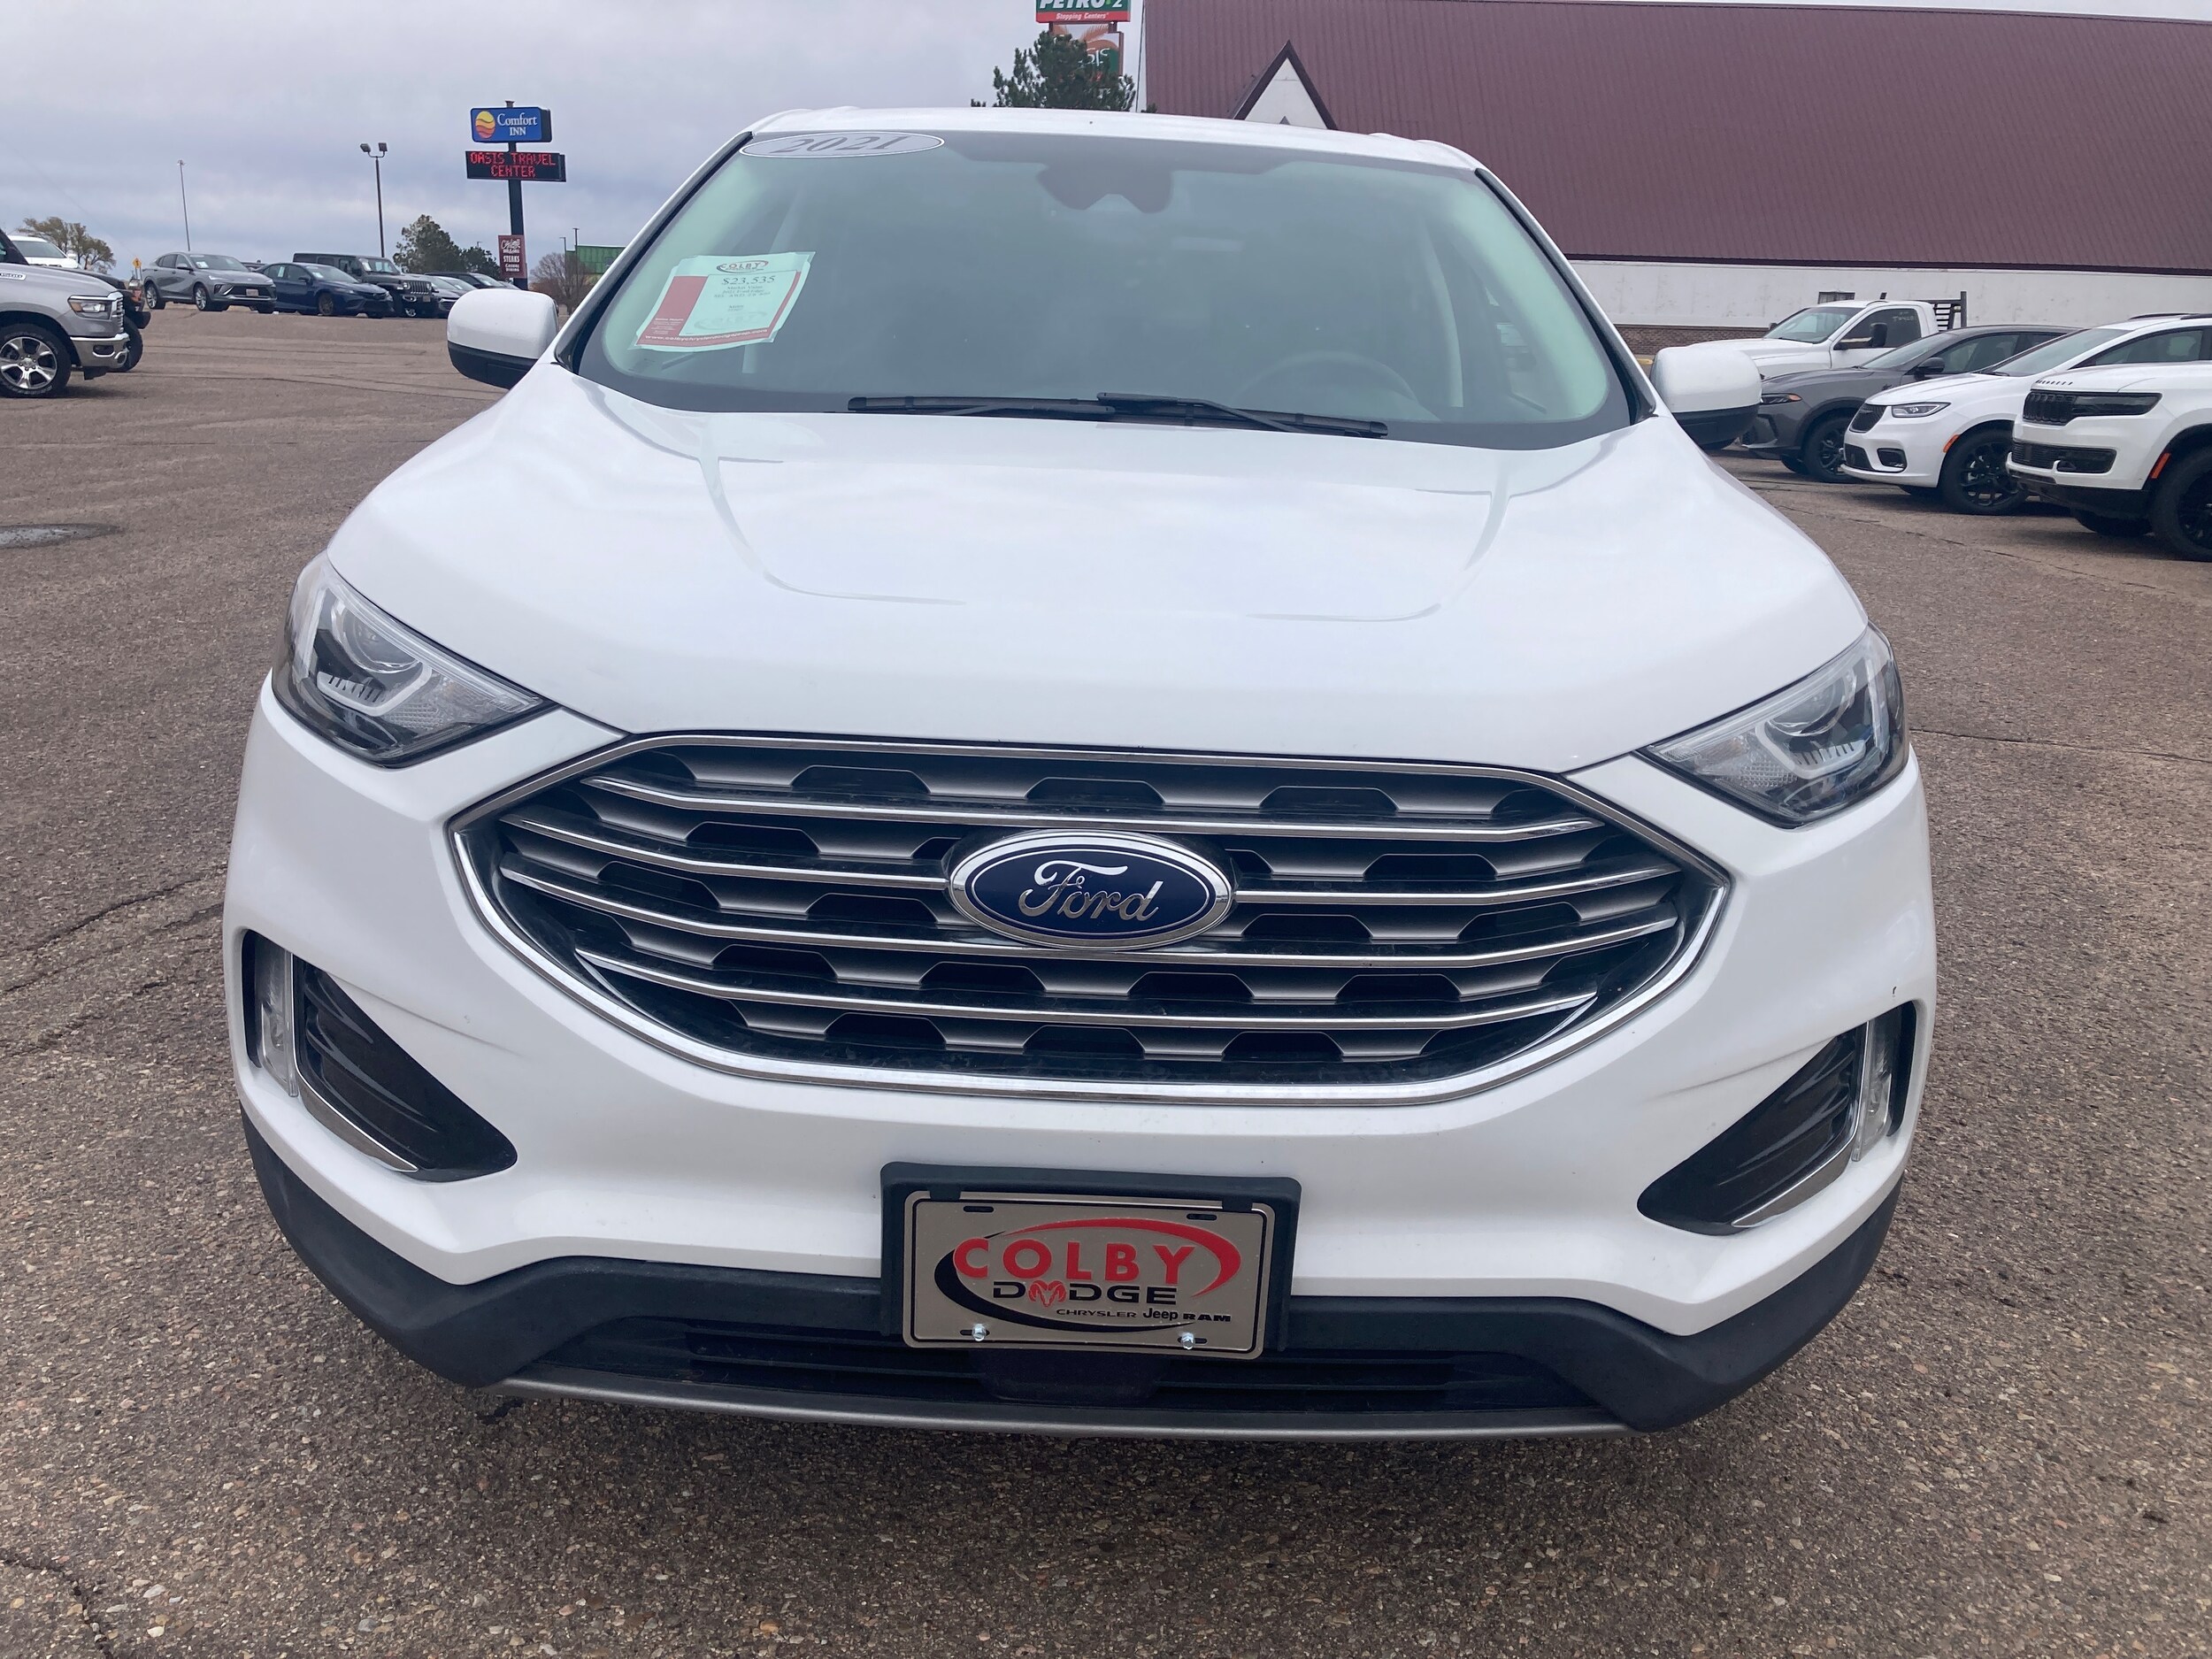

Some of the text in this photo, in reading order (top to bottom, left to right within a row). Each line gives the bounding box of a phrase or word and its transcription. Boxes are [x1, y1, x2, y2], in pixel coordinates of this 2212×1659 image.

[497, 112, 537, 126] Comfort
[510, 127, 526, 136] INN
[769, 135, 911, 154] 2021
[470, 151, 556, 165] OASIS TRAVEL
[490, 165, 536, 177] CENTER
[1018, 859, 1164, 922] Ford
[953, 1237, 1195, 1285] COLBY
[1056, 1307, 1231, 1322] CHRYSLER Jeep RAM
